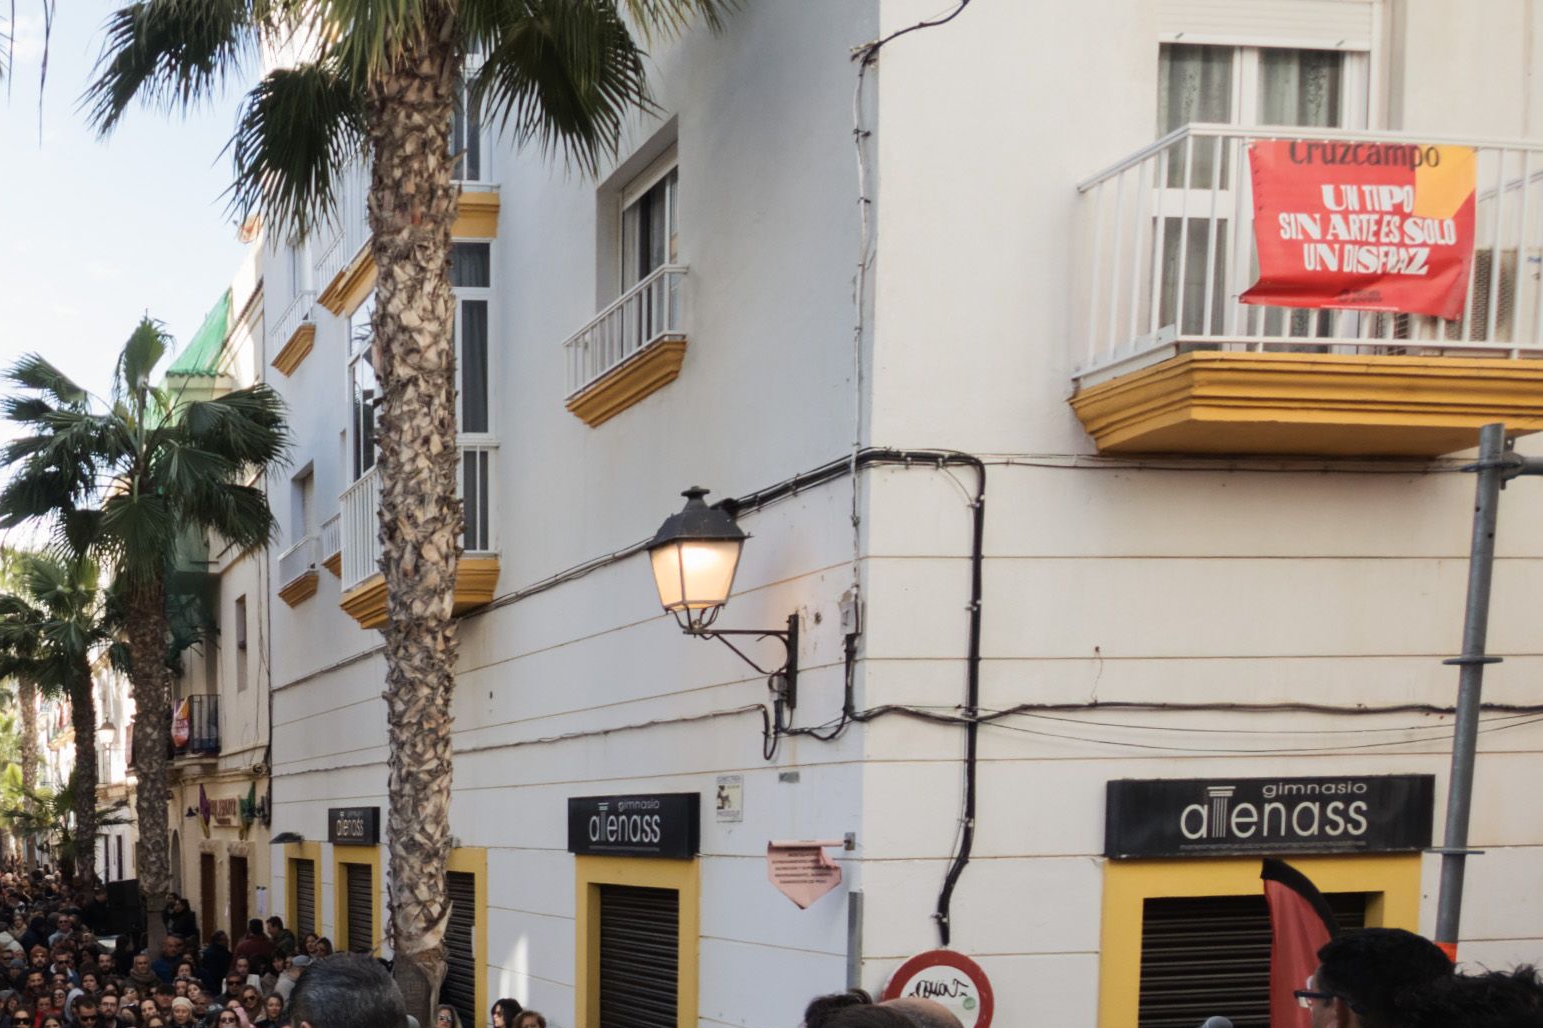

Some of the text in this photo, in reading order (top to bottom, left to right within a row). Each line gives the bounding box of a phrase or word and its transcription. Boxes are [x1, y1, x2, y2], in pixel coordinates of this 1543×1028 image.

[1288, 141, 1441, 171] Cruzcampo
[1321, 184, 1415, 214] UN TIPO
[1278, 213, 1457, 246] SIN ARTE ES SOLO
[1303, 244, 1431, 276] UN DISFRAZ
[1262, 781, 1368, 798] gimnasio
[617, 799, 660, 813] gimnasio
